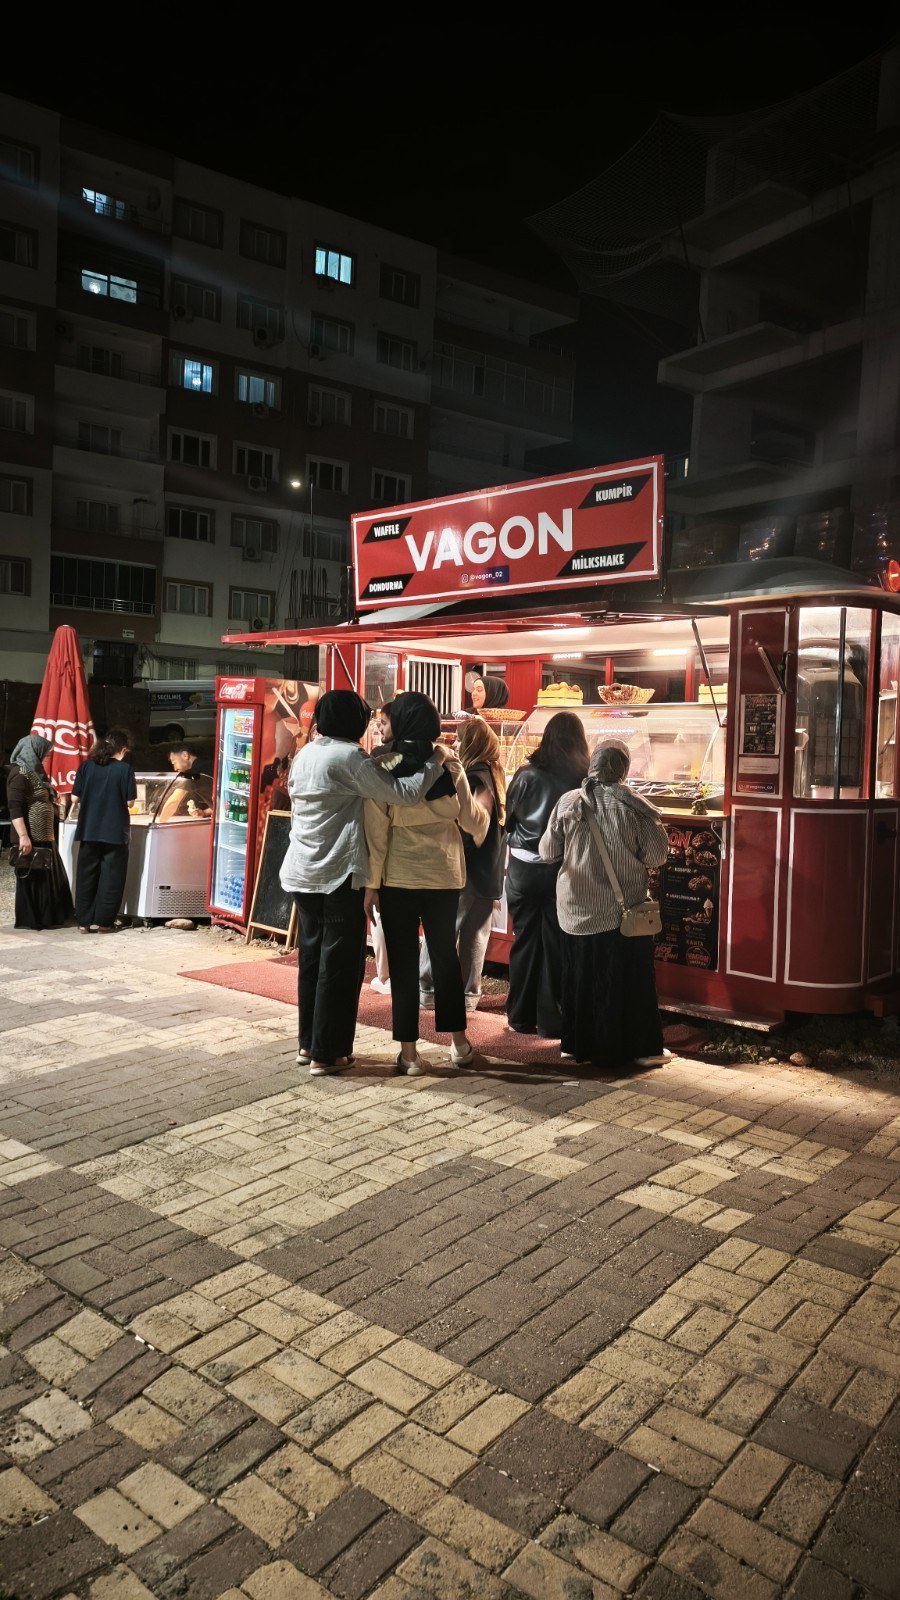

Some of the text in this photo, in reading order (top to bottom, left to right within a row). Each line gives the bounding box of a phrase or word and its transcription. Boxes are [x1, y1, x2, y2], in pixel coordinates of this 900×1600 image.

[595, 483, 633, 502] KUMPİR
[373, 524, 400, 538] WAFFLE
[404, 508, 573, 572] VAGON
[572, 553, 625, 571] MİLKSHAKE
[470, 571, 503, 581] @vagon_02
[368, 580, 403, 593] DONDURMA
